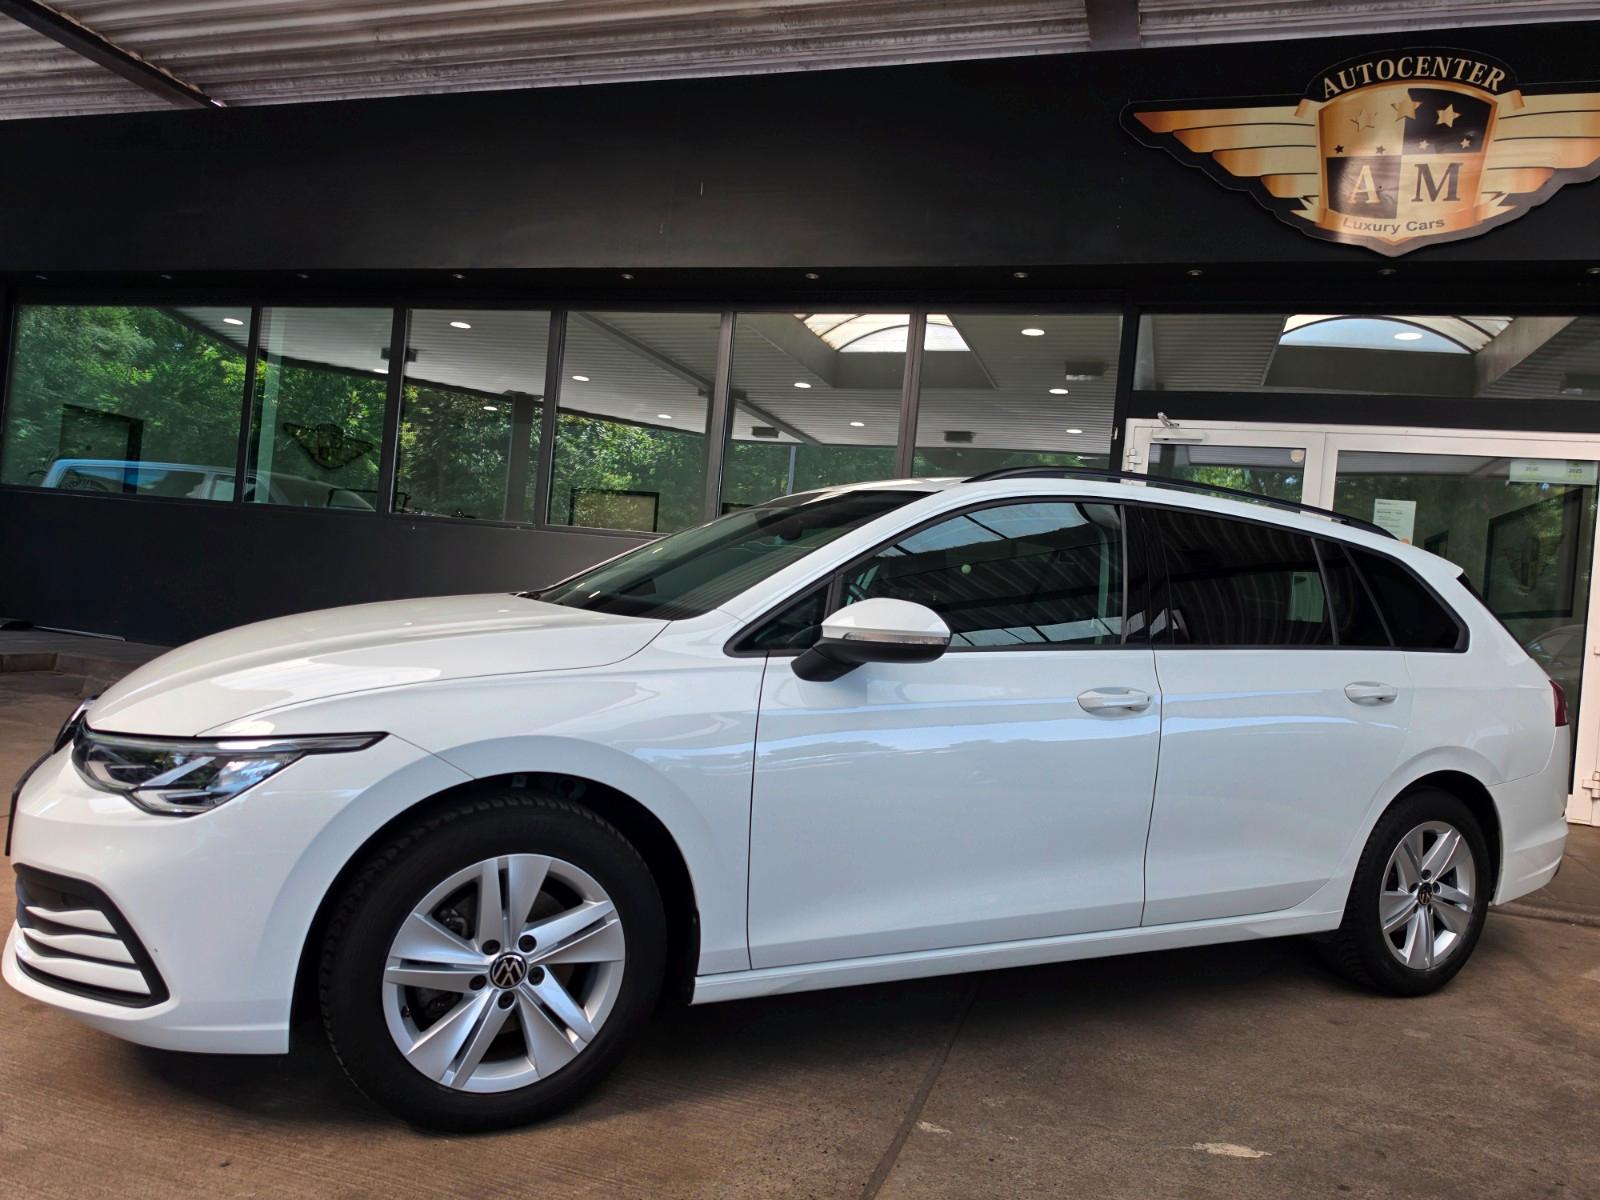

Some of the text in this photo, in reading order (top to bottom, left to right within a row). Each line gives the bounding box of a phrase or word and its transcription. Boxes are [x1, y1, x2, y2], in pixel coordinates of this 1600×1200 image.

[1323, 56, 1506, 99] AUTOCENTER
[1347, 162, 1463, 204] A M
[1343, 217, 1446, 234] Luxury Cars
